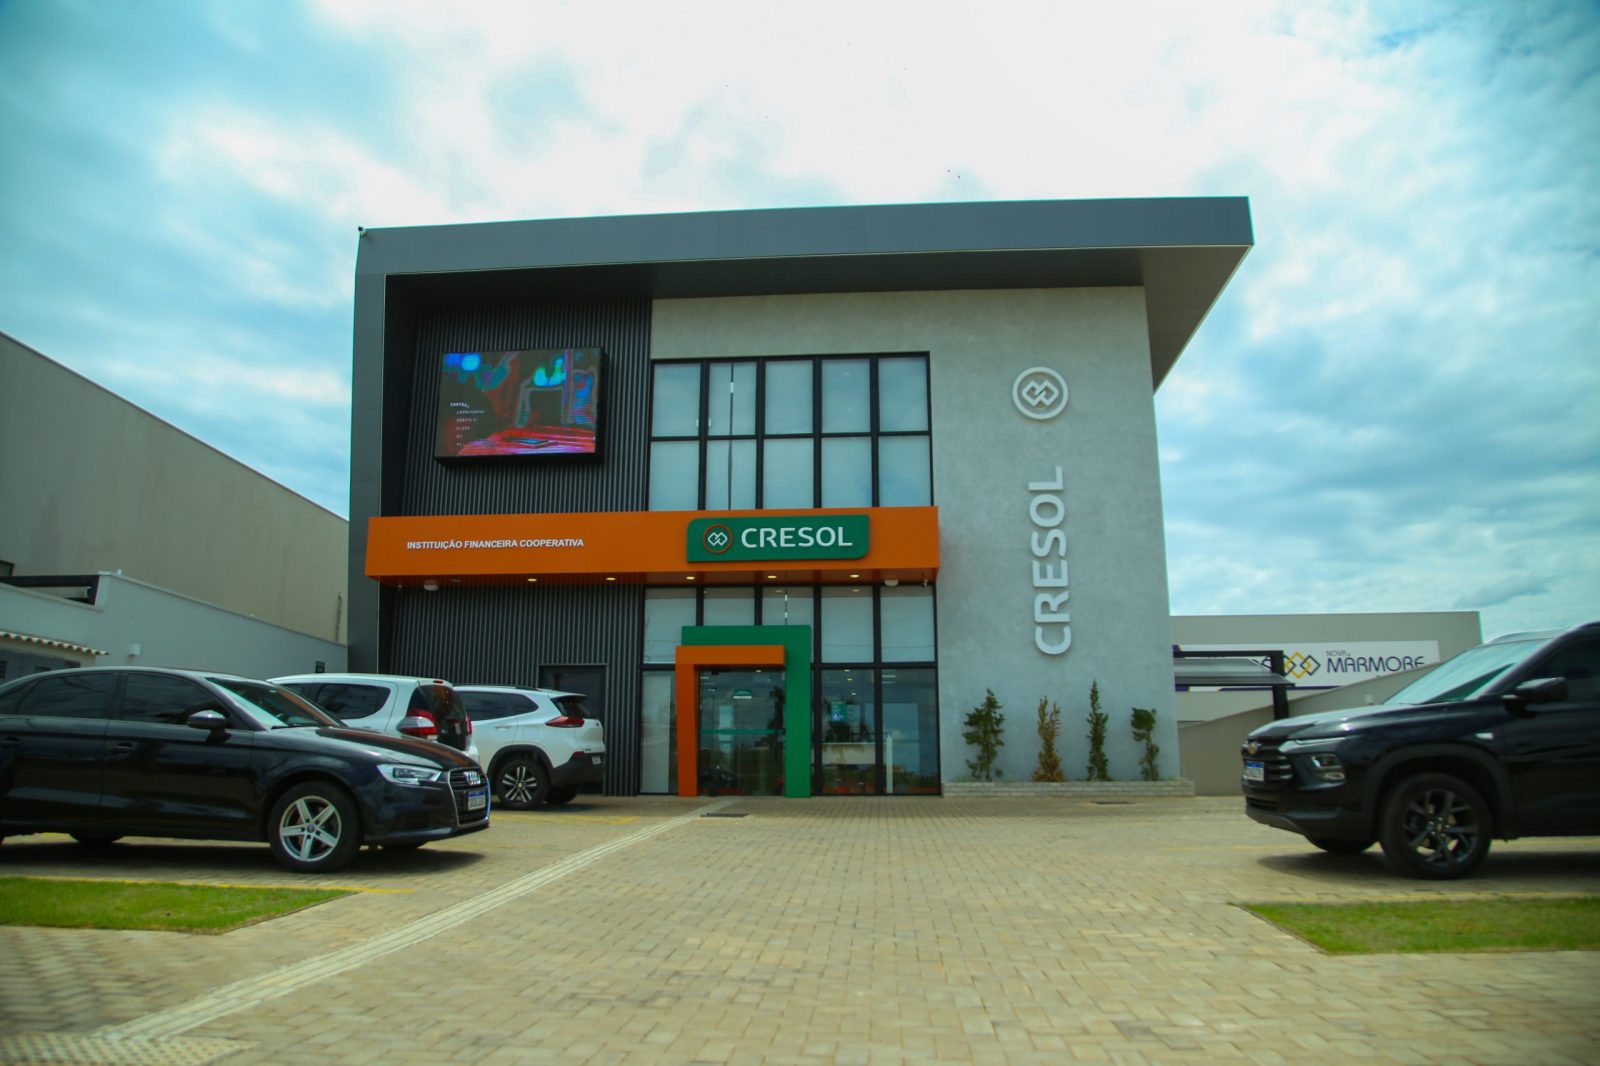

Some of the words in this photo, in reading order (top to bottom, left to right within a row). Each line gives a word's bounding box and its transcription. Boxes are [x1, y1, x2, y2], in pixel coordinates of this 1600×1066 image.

[407, 539, 463, 549] INSTITUIÇÃO
[464, 540, 518, 549] FINANCEIRA
[519, 538, 584, 548] COOPERATIVA
[741, 526, 853, 548] CRESOL
[1028, 465, 1072, 656] CRESOL
